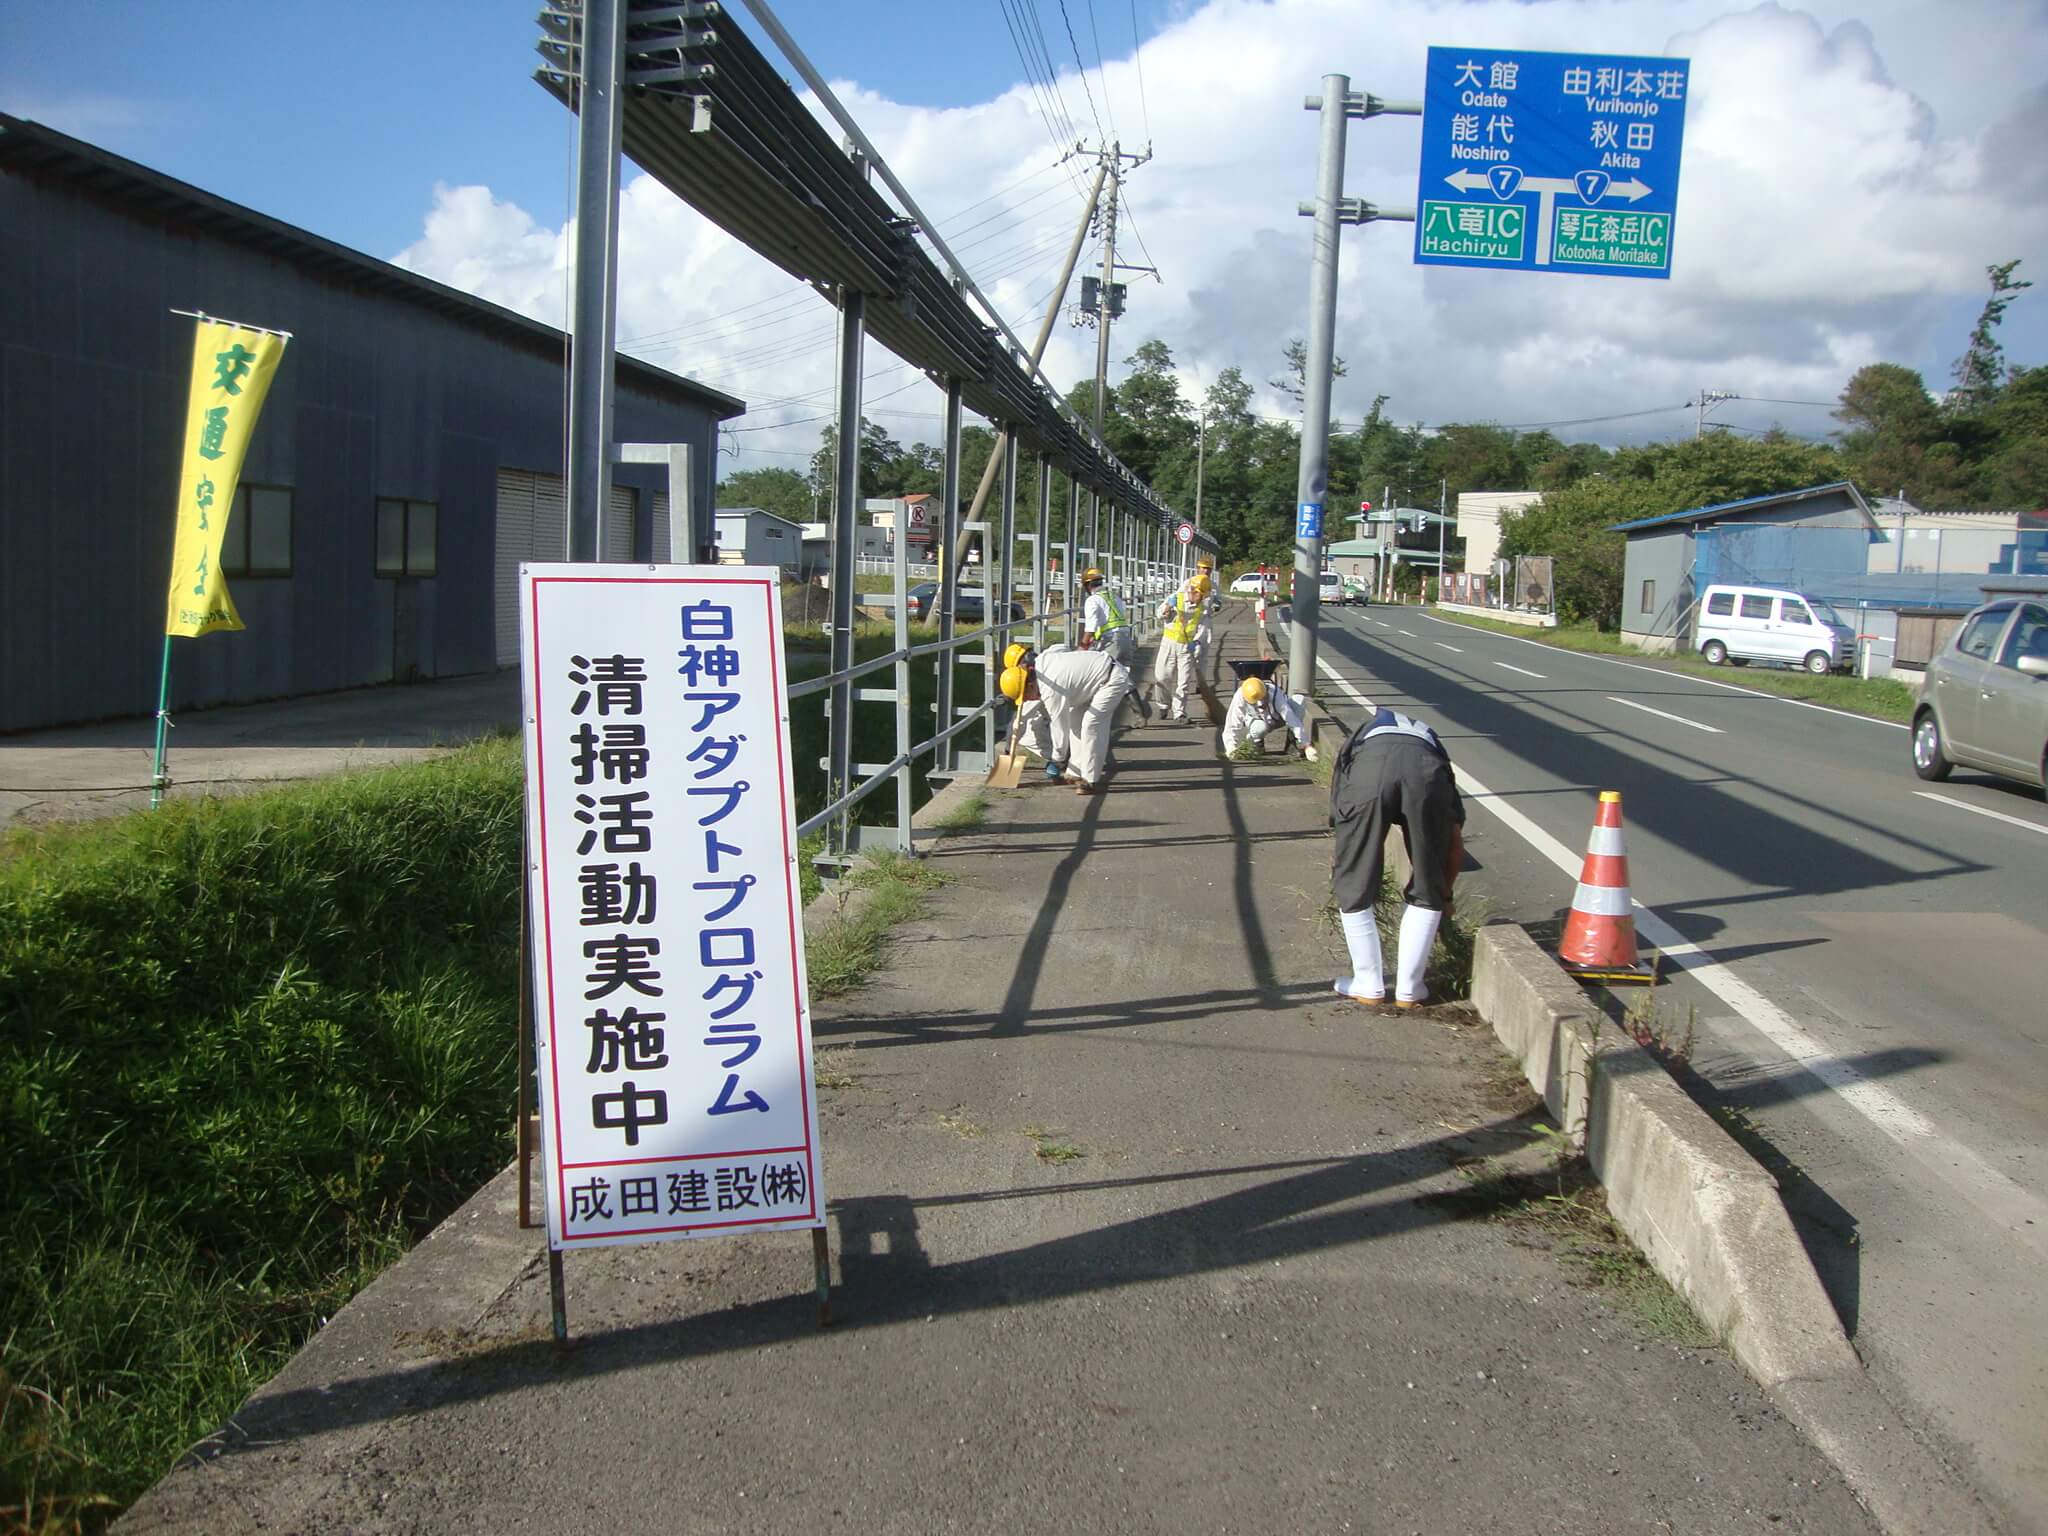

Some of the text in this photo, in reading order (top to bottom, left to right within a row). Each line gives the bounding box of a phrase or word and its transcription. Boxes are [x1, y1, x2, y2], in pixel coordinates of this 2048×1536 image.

[1453, 59, 1519, 91] 大館
[1563, 66, 1684, 101] 由利本荘
[1461, 91, 1507, 108] Odate
[1586, 97, 1659, 117] Yurihonjo
[1451, 114, 1514, 144] 能代
[1590, 120, 1654, 150] 秋田
[1451, 144, 1510, 162] Noshiro
[1601, 152, 1640, 169] Akita
[1499, 171, 1512, 190] 7
[1586, 175, 1599, 195] 7
[1425, 236, 1508, 257] Hachiryu
[1558, 243, 1658, 264] Kotooka Moritake
[677, 599, 770, 1116] 白神アダプトプログラム
[567, 654, 669, 1145] 清掃活動実施中
